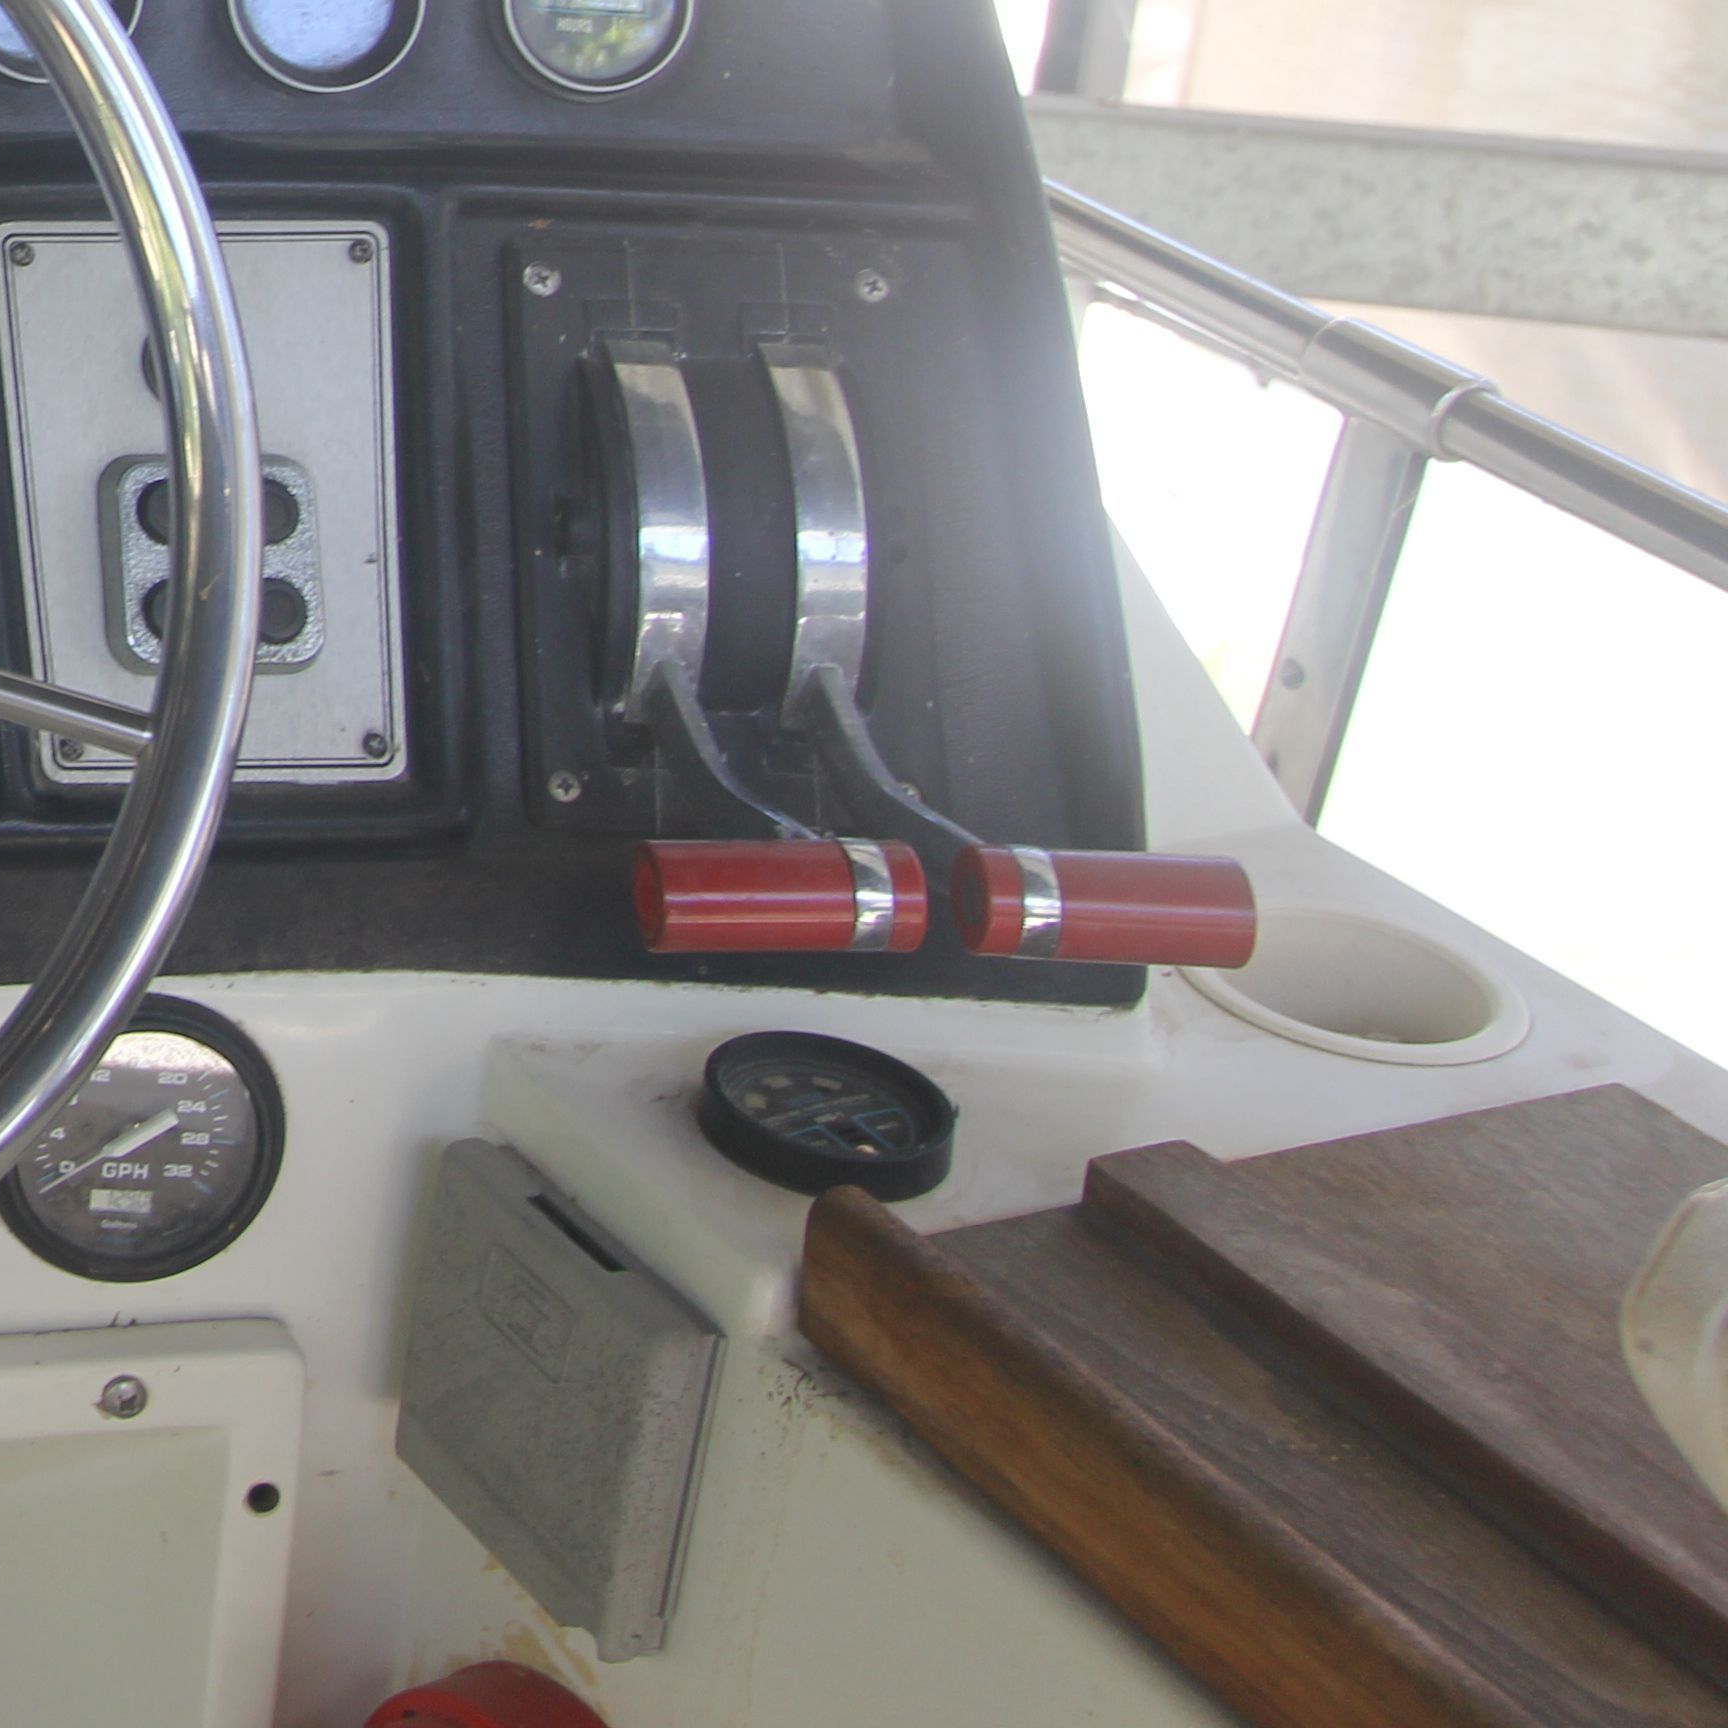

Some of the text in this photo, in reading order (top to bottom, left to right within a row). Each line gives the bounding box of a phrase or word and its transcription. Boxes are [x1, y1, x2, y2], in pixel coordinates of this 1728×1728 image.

[157, 1071, 188, 1086] 20
[176, 1099, 207, 1114] 24
[48, 1126, 211, 1146] 4 28
[100, 1161, 150, 1180] GPH
[162, 1163, 194, 1178] 32
